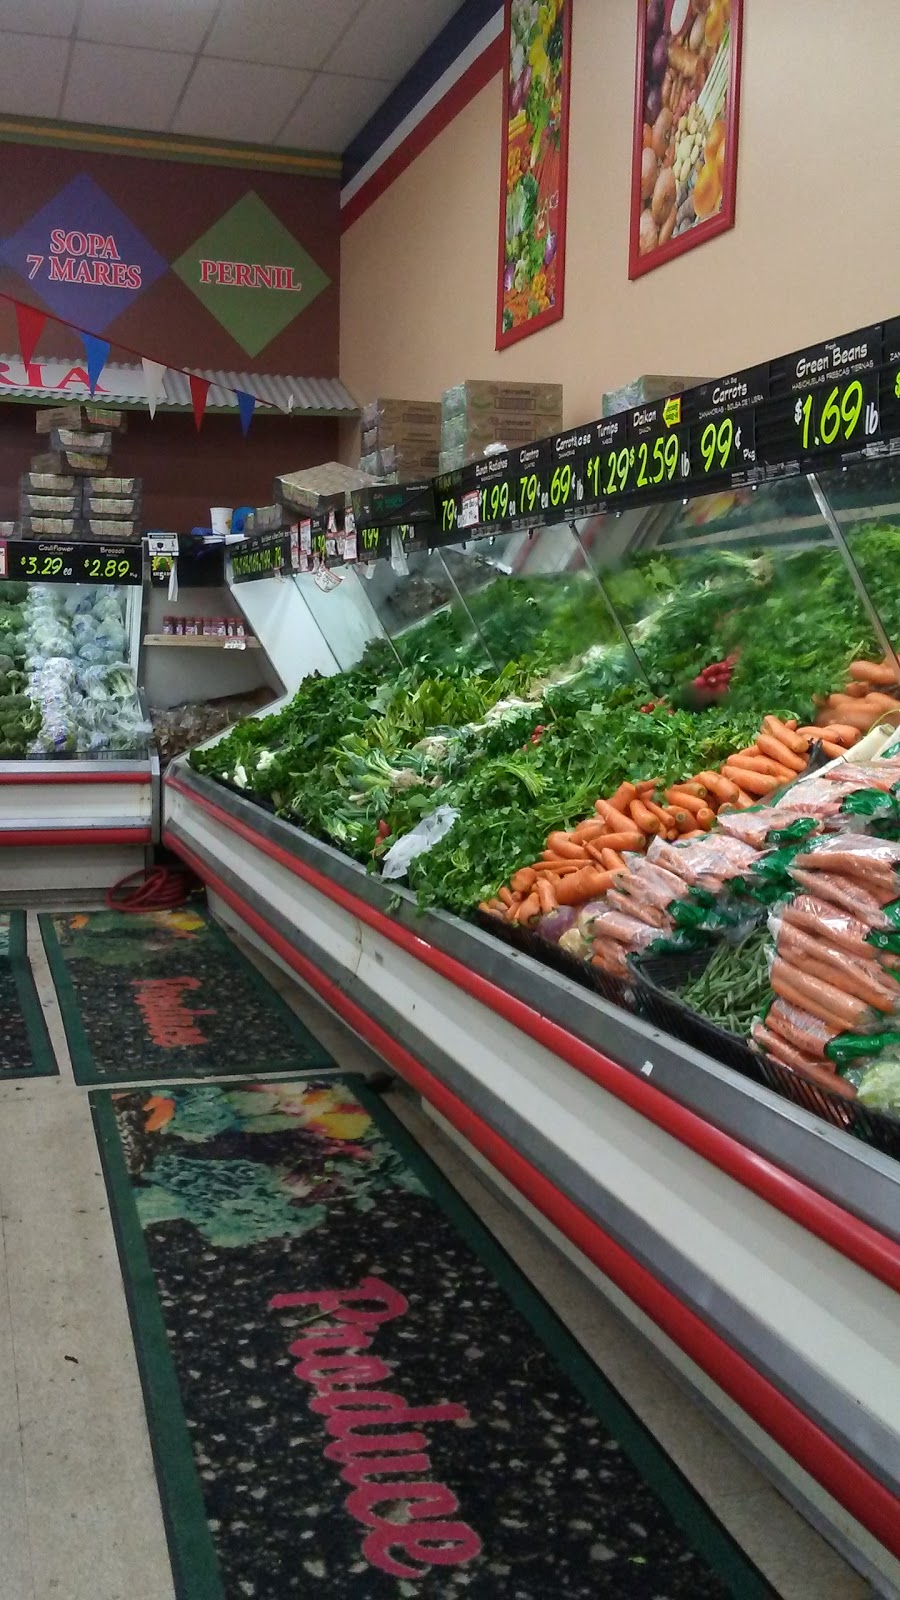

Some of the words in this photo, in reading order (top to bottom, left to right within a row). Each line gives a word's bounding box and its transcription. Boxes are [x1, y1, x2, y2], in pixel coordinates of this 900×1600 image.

[50, 229, 120, 260] SOPA
[26, 255, 43, 280] 7
[49, 256, 142, 289] MARES
[200, 260, 302, 291] PERNIL
[795, 356, 829, 378] Green
[832, 343, 868, 367] Beans
[712, 382, 748, 405] Carrots
[633, 409, 657, 428] Daikon
[794, 380, 863, 450] $1.69
[865, 402, 879, 435] lb
[596, 421, 619, 438] Turnips
[587, 447, 630, 497] $1.29
[629, 433, 679, 488] $2.59
[681, 451, 691, 478] lb
[576, 478, 584, 501] lb
[38, 544, 74, 553] Cauliflower
[100, 546, 125, 555] Broccoli
[20, 556, 63, 576] $3.29
[63, 567, 73, 576] ea
[83, 558, 130, 578] $2.89
[268, 1276, 482, 1579] Produce
